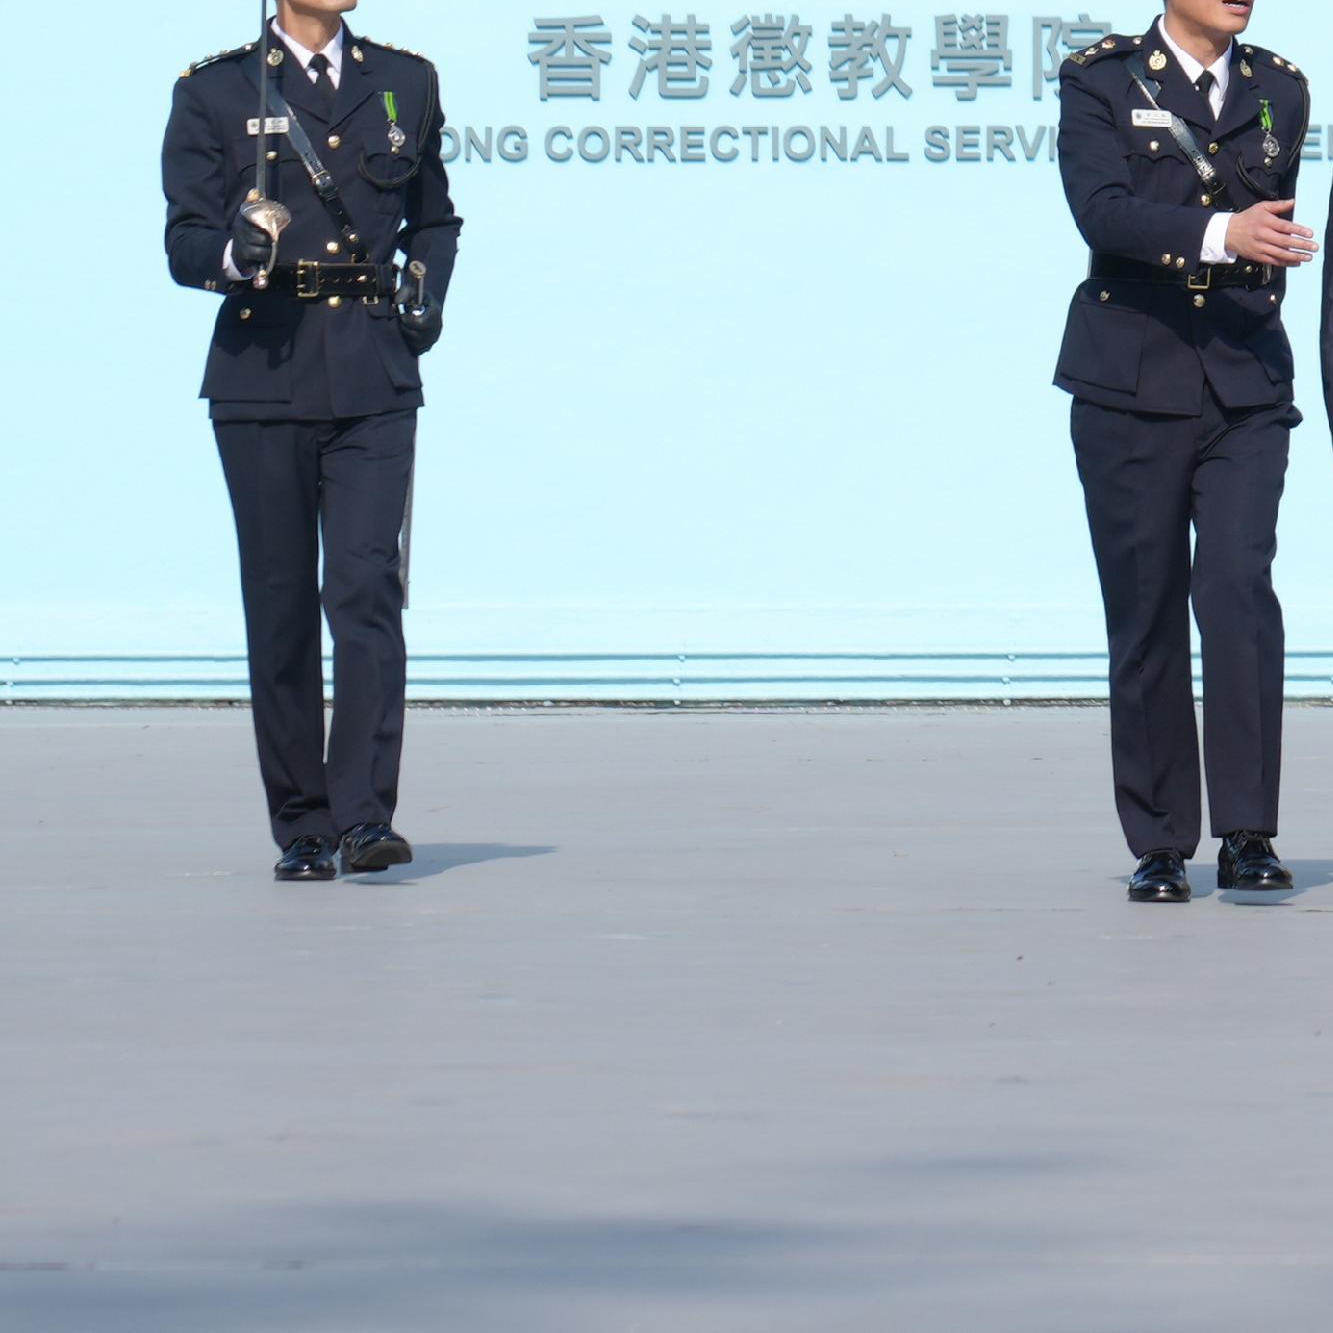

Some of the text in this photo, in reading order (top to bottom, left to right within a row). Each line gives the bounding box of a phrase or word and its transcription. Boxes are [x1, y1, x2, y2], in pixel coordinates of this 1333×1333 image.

[527, 13, 1112, 102] 香港懲教學院
[438, 124, 1057, 164] ONG CORRECTIONAL SERVI
